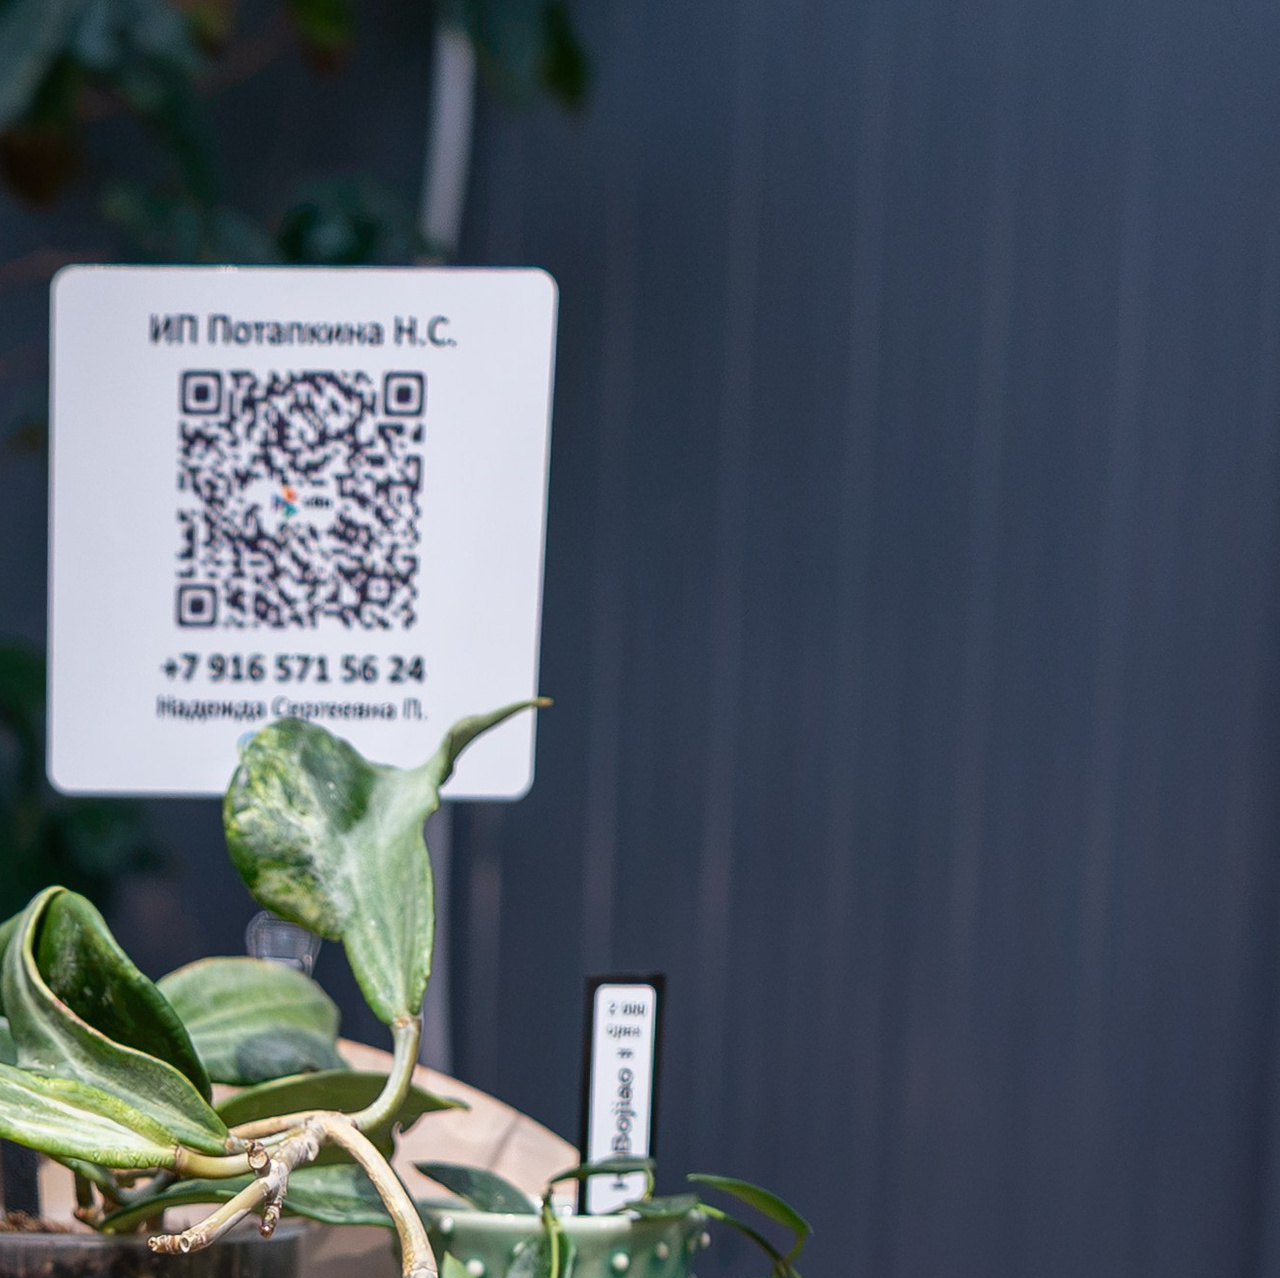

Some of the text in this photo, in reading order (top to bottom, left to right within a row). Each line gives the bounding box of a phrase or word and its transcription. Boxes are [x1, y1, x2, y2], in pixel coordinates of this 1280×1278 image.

[148, 314, 458, 347] ИП Потапкина Н.С.
[161, 654, 425, 683] +7 916 571 56 24
